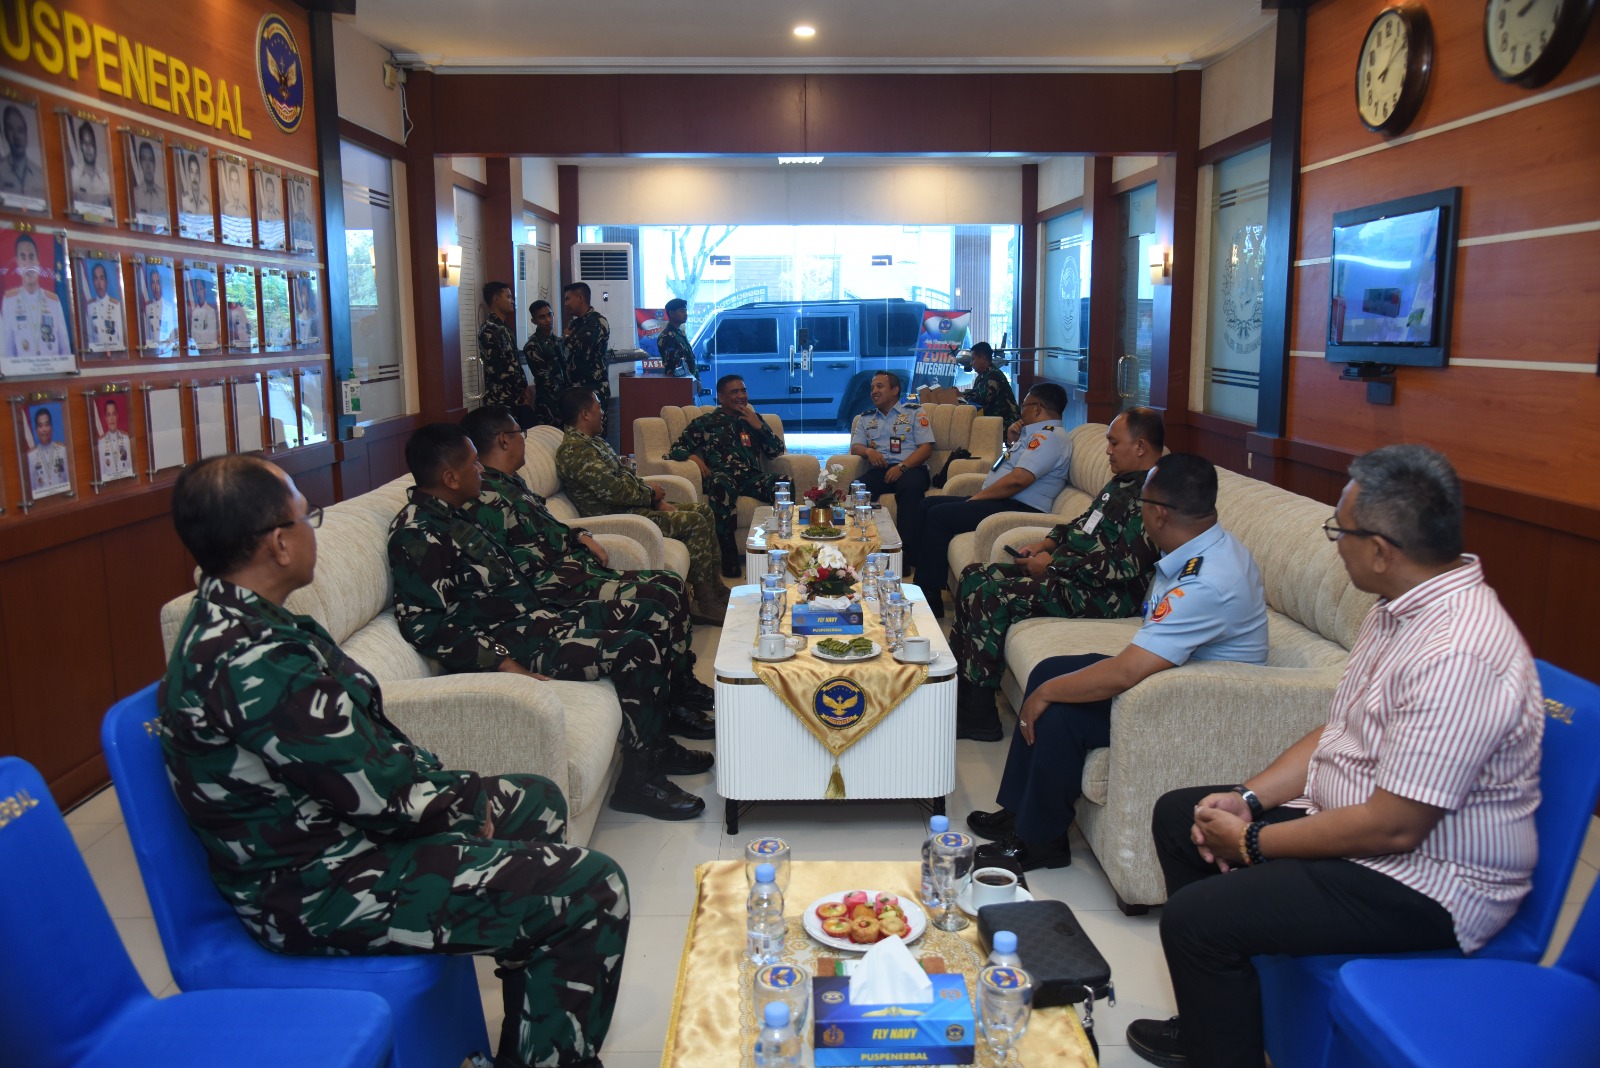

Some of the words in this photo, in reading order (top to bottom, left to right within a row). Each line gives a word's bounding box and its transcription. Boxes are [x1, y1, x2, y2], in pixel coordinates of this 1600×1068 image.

[915, 362, 958, 376] INTEGRITAS
[872, 1028, 888, 1039] FLY
[890, 1028, 917, 1039] NAVY
[861, 1053, 928, 1061] PUSPENERBAL
